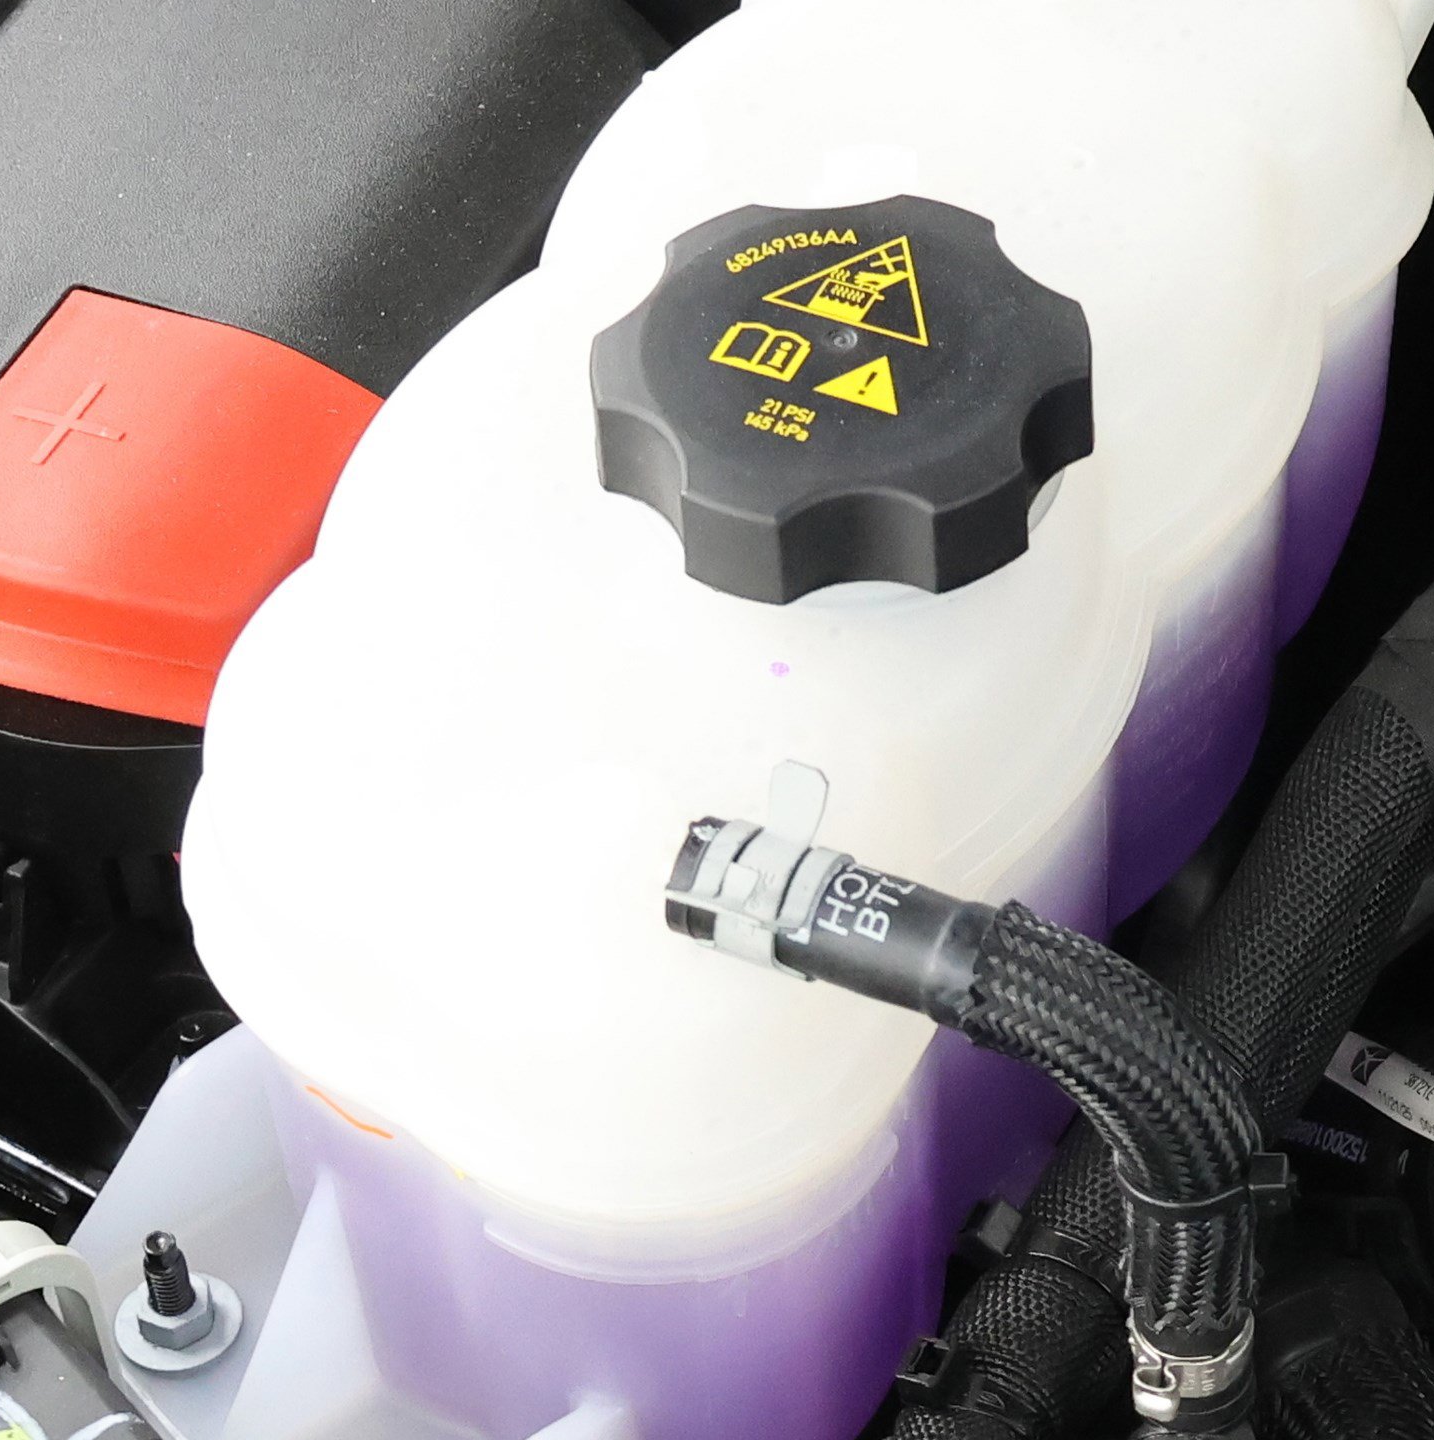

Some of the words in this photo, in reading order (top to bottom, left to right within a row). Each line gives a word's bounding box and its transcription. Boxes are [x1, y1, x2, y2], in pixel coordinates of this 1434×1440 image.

[725, 229, 857, 274] 68249136AA
[760, 397, 783, 415] 21
[782, 403, 815, 424] PSI
[773, 418, 810, 442] kPa
